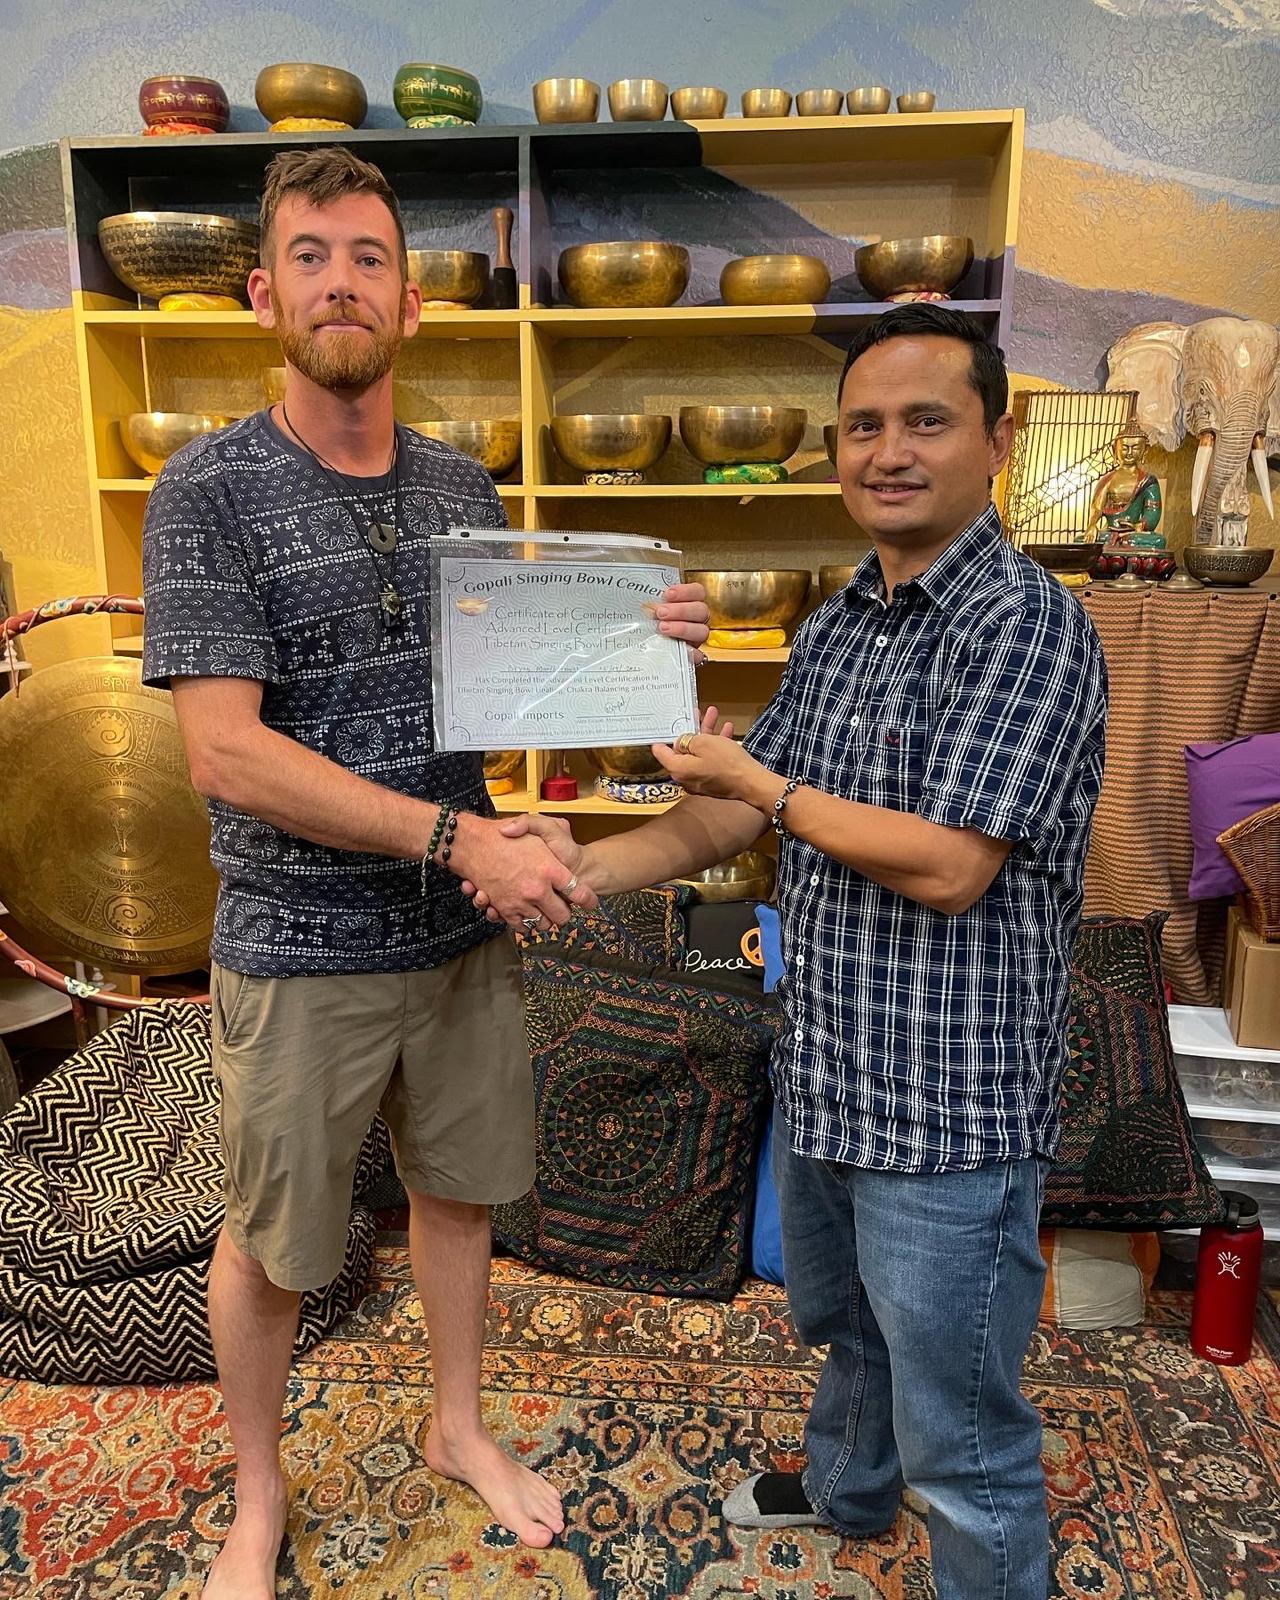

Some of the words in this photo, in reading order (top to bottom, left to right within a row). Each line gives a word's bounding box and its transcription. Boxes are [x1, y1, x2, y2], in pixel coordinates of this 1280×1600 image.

[463, 575, 512, 594] Gopali
[516, 572, 572, 585] Singing
[576, 572, 613, 586] Bowl
[616, 577, 665, 598] Center
[494, 606, 555, 621] Certificate
[557, 606, 568, 620] of
[570, 607, 633, 623] Completion
[484, 621, 541, 635] Advanced
[543, 622, 573, 635] Level
[575, 621, 642, 636] Certifion
[482, 636, 527, 650] Tibetan
[529, 637, 572, 652] Singing
[574, 637, 602, 650] Bowl
[605, 637, 647, 652] Healing
[475, 676, 490, 684] Has
[491, 676, 532, 685] Completed
[584, 675, 604, 683] Level
[605, 674, 651, 683] Certification
[457, 686, 485, 694] Tibetan
[487, 686, 514, 695] Singing
[515, 686, 534, 694] Bowl
[566, 685, 593, 694] Chakra
[594, 684, 631, 693] Balancing
[632, 683, 645, 691] and
[646, 682, 679, 691] Chanting
[684, 949, 752, 973] Peace
